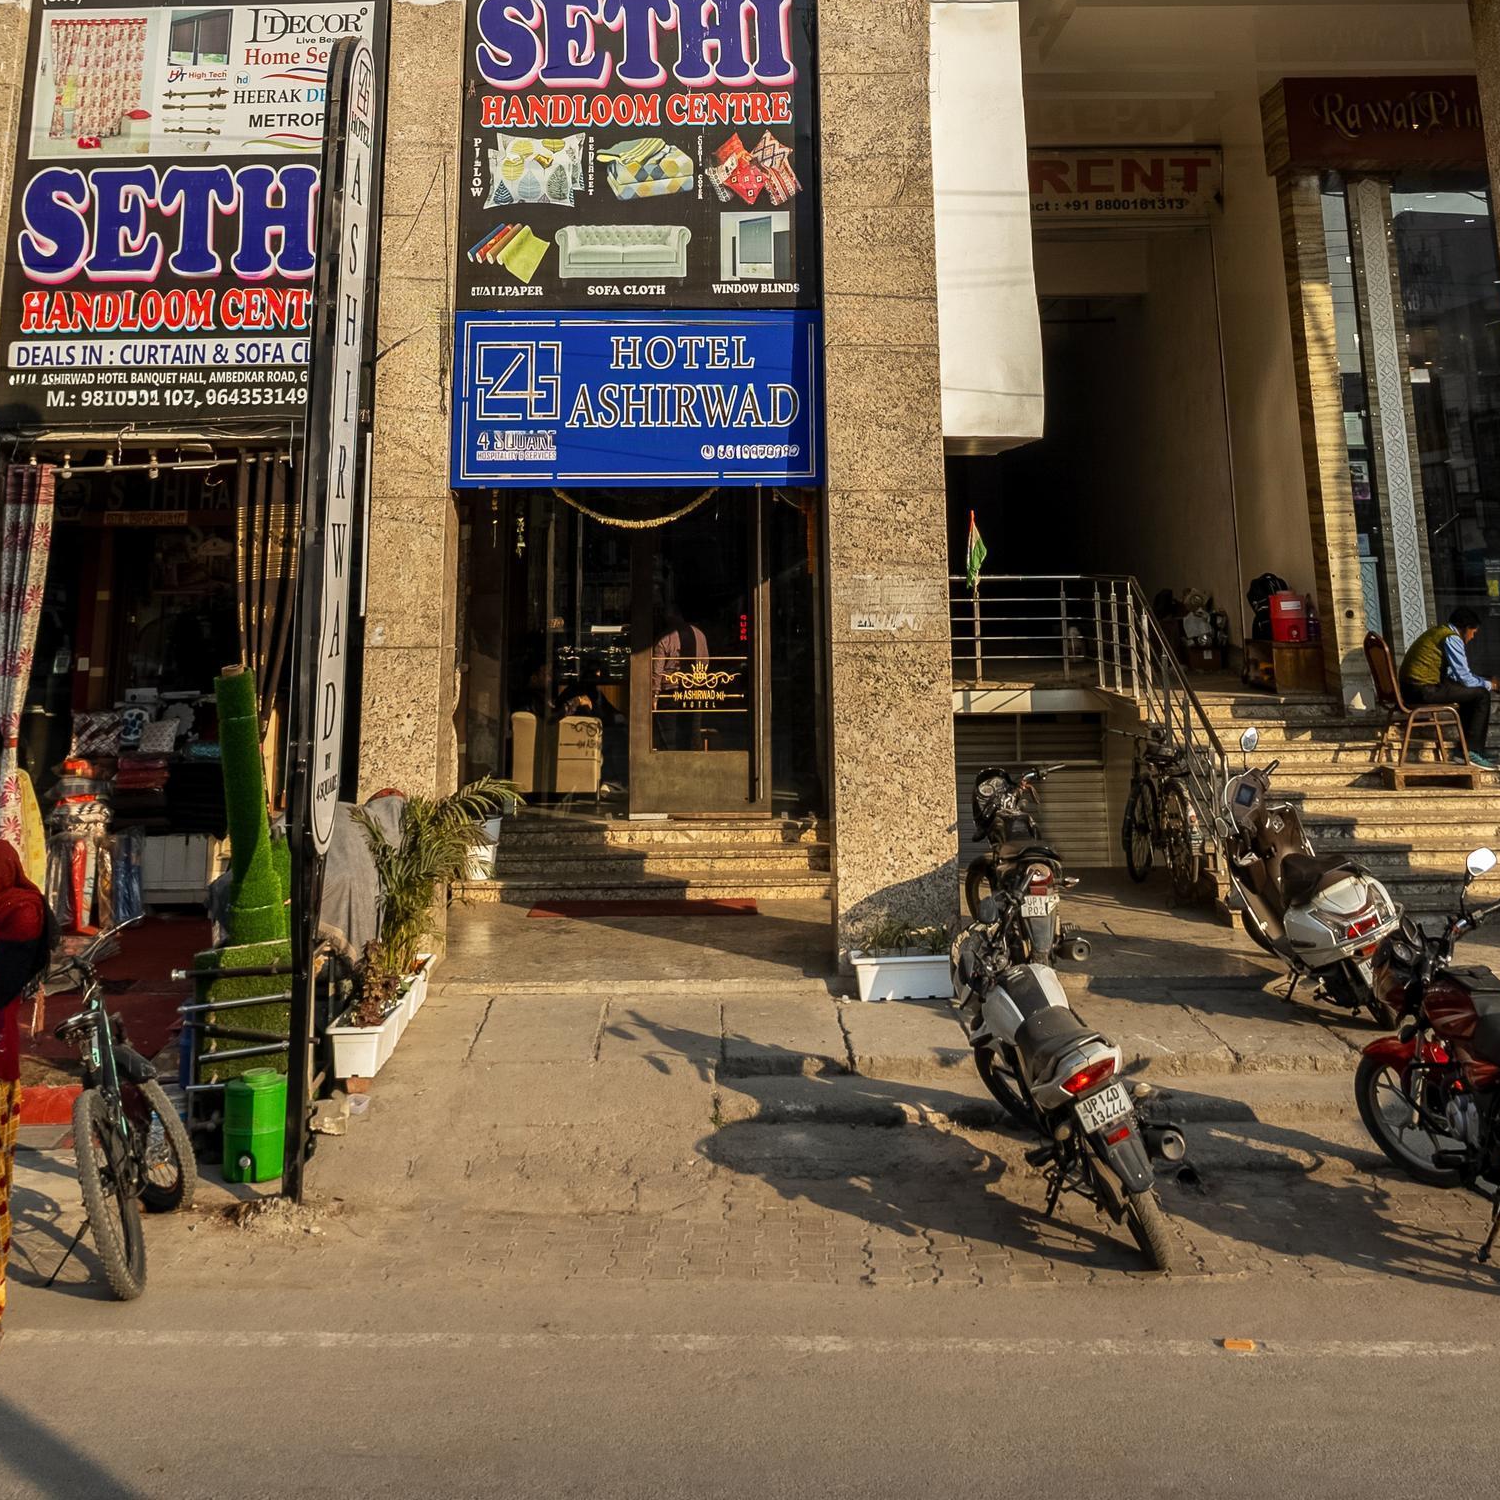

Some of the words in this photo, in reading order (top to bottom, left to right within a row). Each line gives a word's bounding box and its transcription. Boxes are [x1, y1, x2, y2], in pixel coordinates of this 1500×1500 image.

[296, 36, 315, 44] Live
[244, 48, 300, 66] Home
[188, 71, 207, 82] High
[209, 70, 227, 80] Tech
[233, 89, 302, 104] HEERAK
[480, 93, 662, 129] HANDLOOM
[666, 91, 793, 127] CENTRE
[249, 114, 325, 128] METROP
[351, 110, 371, 150] HOTEL
[1063, 201, 1090, 211] +91
[18, 164, 320, 284] SETH
[587, 285, 619, 296] SOFA
[622, 284, 667, 295] CLOTH
[712, 283, 759, 295] WINDOW
[760, 282, 800, 293] BLINDS
[20, 288, 216, 334] HANDLOOM
[220, 287, 315, 332] CENT
[16, 345, 75, 366] DEALS
[81, 345, 101, 365] IN
[120, 344, 206, 365] CURTAIN
[212, 343, 228, 364] &
[234, 342, 285, 364] SOFA
[609, 335, 756, 370] HOTEL
[41, 372, 95, 386] ASHIRWAD
[97, 372, 128, 385] HOTEL
[130, 371, 177, 386] BANQUET
[179, 371, 207, 385] HALL,
[208, 370, 265, 383] AMBEDKAR
[266, 370, 298, 384] ROAD,
[206, 388, 308, 405] 964353149
[564, 383, 801, 429] ASHIRWAD
[477, 432, 490, 451] 4
[476, 451, 518, 461] HOSPITALITY
[525, 451, 557, 460] SERVICES
[683, 689, 716, 701] ASHIRWAD
